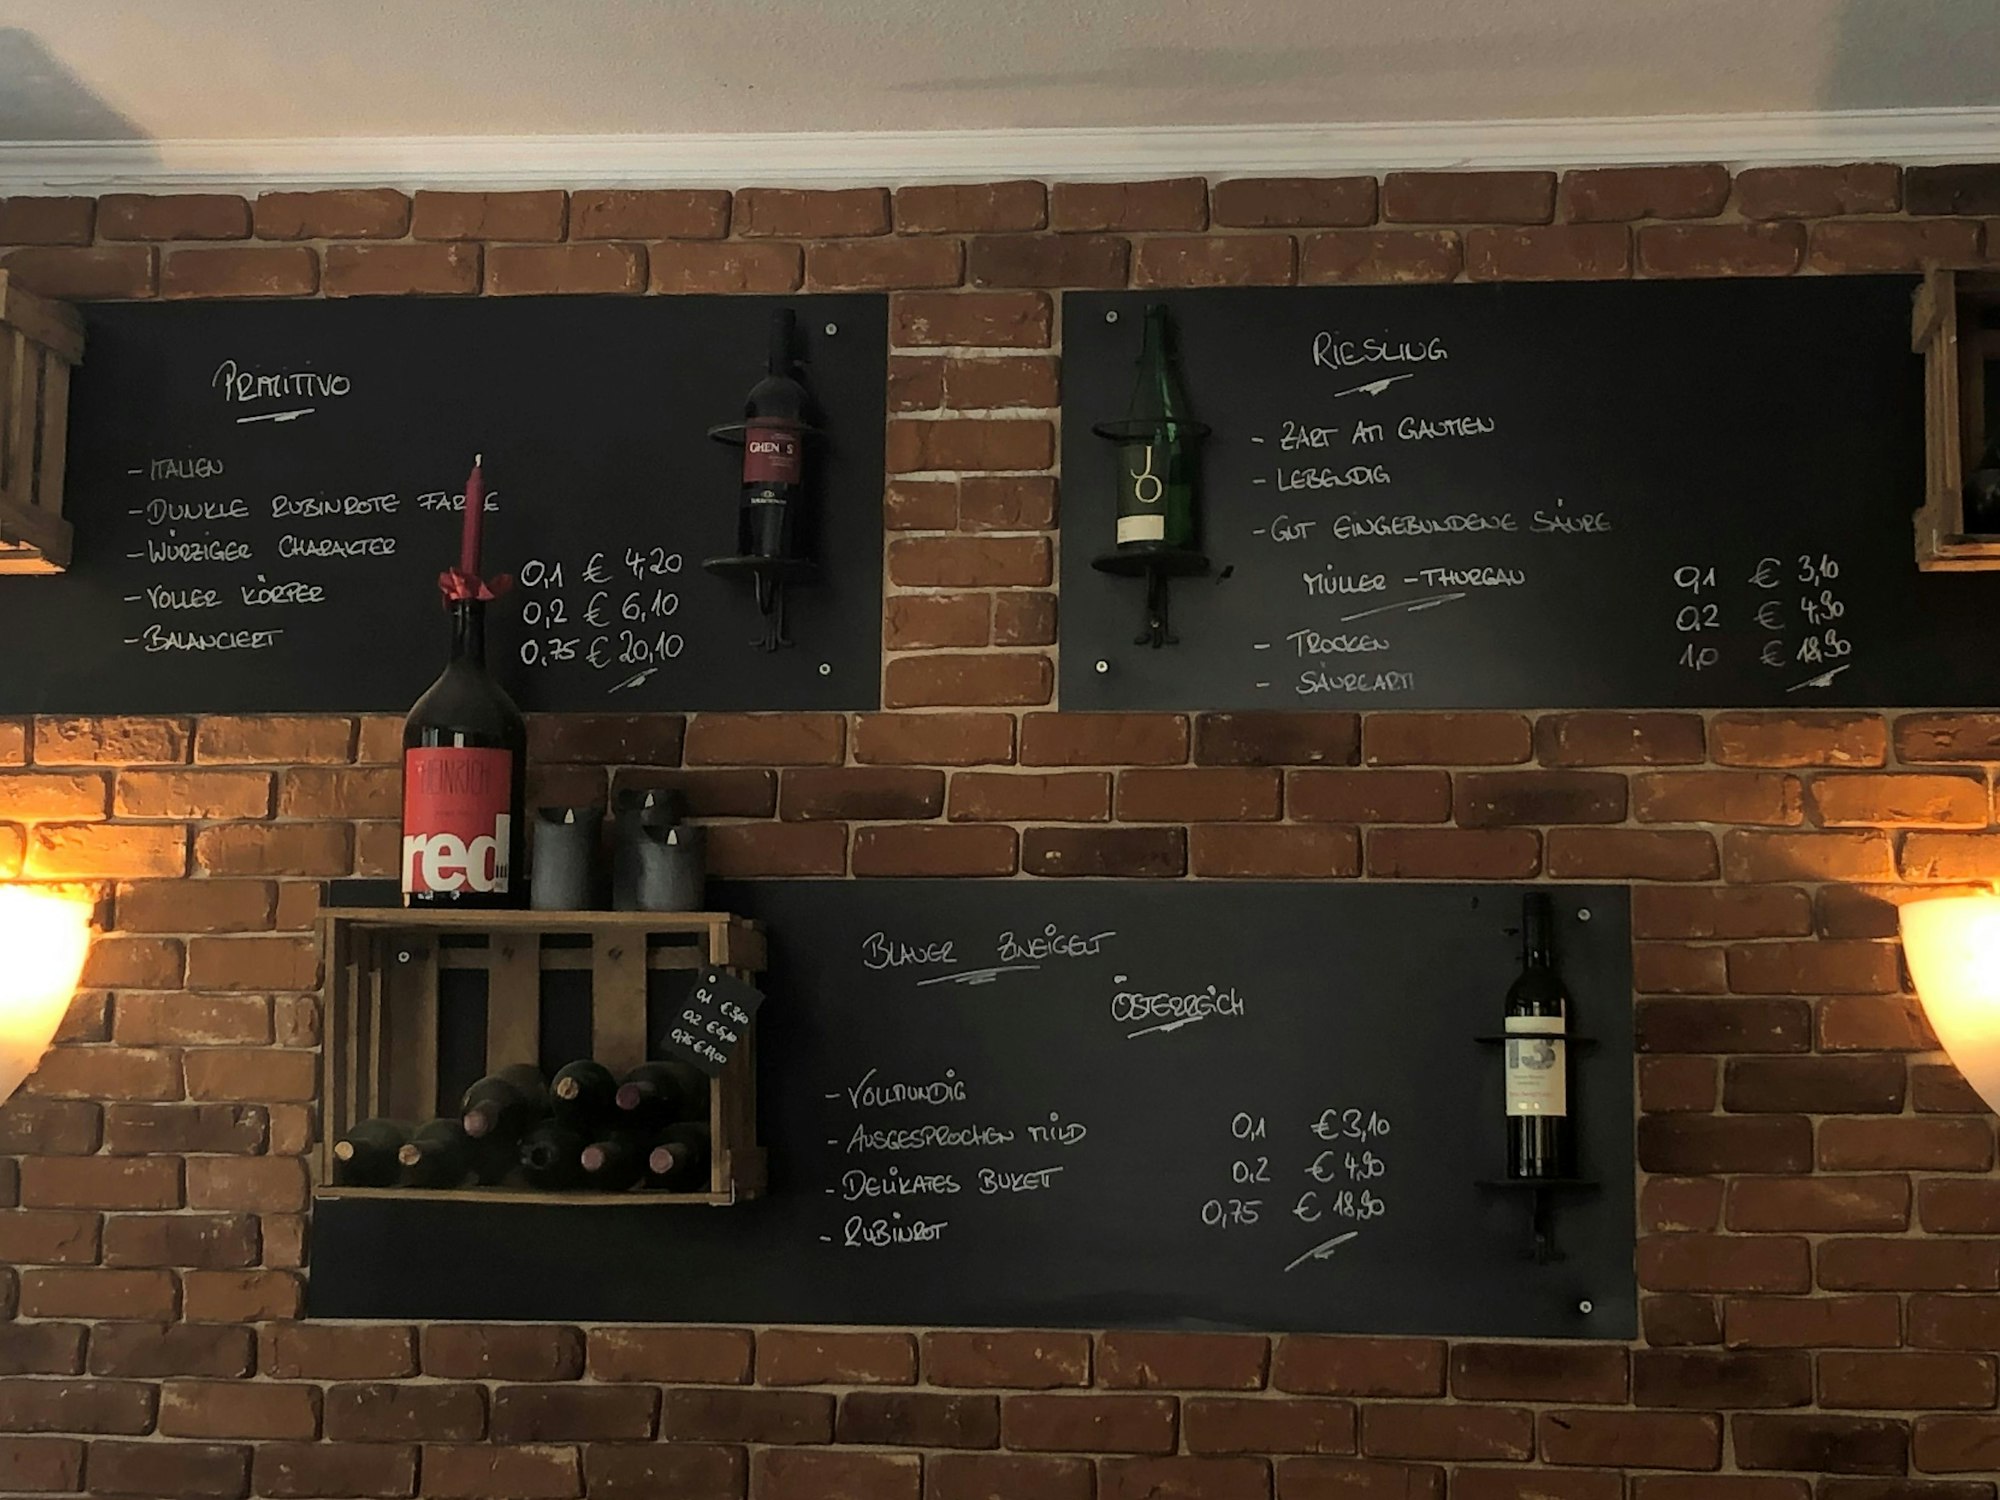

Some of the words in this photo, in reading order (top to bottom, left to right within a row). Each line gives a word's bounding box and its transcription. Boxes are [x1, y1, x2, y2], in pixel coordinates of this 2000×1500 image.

[1312, 331, 1448, 370] RIESLING
[749, 441, 794, 455] GHENS
[1280, 420, 1339, 451] ZART
[1397, 416, 1495, 440] GAUMEN
[150, 457, 224, 481] ITALIEN
[1277, 464, 1391, 492] LEBENDIG
[146, 498, 250, 525] DUNKLE
[271, 493, 401, 518] RUBINROTE
[417, 490, 502, 513] FARE
[1270, 514, 1317, 542] GUT
[1333, 512, 1516, 540] EINGEBUNDENE
[1529, 498, 1610, 534] SÄURE
[147, 528, 253, 564] WÜRZIGER
[278, 534, 396, 558] CHARAKTER
[520, 559, 563, 589] 0,1
[581, 552, 613, 584] €
[625, 547, 683, 581] 4,20
[1302, 563, 1387, 596] MÜLLER
[1673, 566, 1716, 595] 0,1
[1747, 557, 1781, 589] €
[1798, 553, 1840, 587] 3,10
[146, 584, 223, 610] VOLLER
[240, 574, 326, 606] KÖRPER
[522, 598, 568, 629] 0,2
[582, 591, 610, 628] €
[621, 588, 679, 623] 6,10
[1675, 603, 1720, 632] 0,2
[1753, 600, 1785, 630] €
[142, 624, 284, 652] BALANCIERT
[520, 638, 581, 667] 0,75
[585, 635, 611, 669] €
[618, 629, 684, 664] 20,10
[1759, 639, 1786, 667] €
[402, 813, 511, 893] red
[862, 931, 958, 970] BLAUER
[846, 1123, 1015, 1153] AUSGESPROCHEN
[1027, 1111, 1087, 1145] MILD
[1231, 1112, 1266, 1142] 0,1
[842, 1166, 962, 1201] DELIKATES
[1232, 1156, 1271, 1184] 0,2
[1304, 1150, 1335, 1183] €
[1201, 1199, 1263, 1229] 0,75
[1292, 1191, 1322, 1222] €
[844, 1211, 948, 1247] RUBINROT
